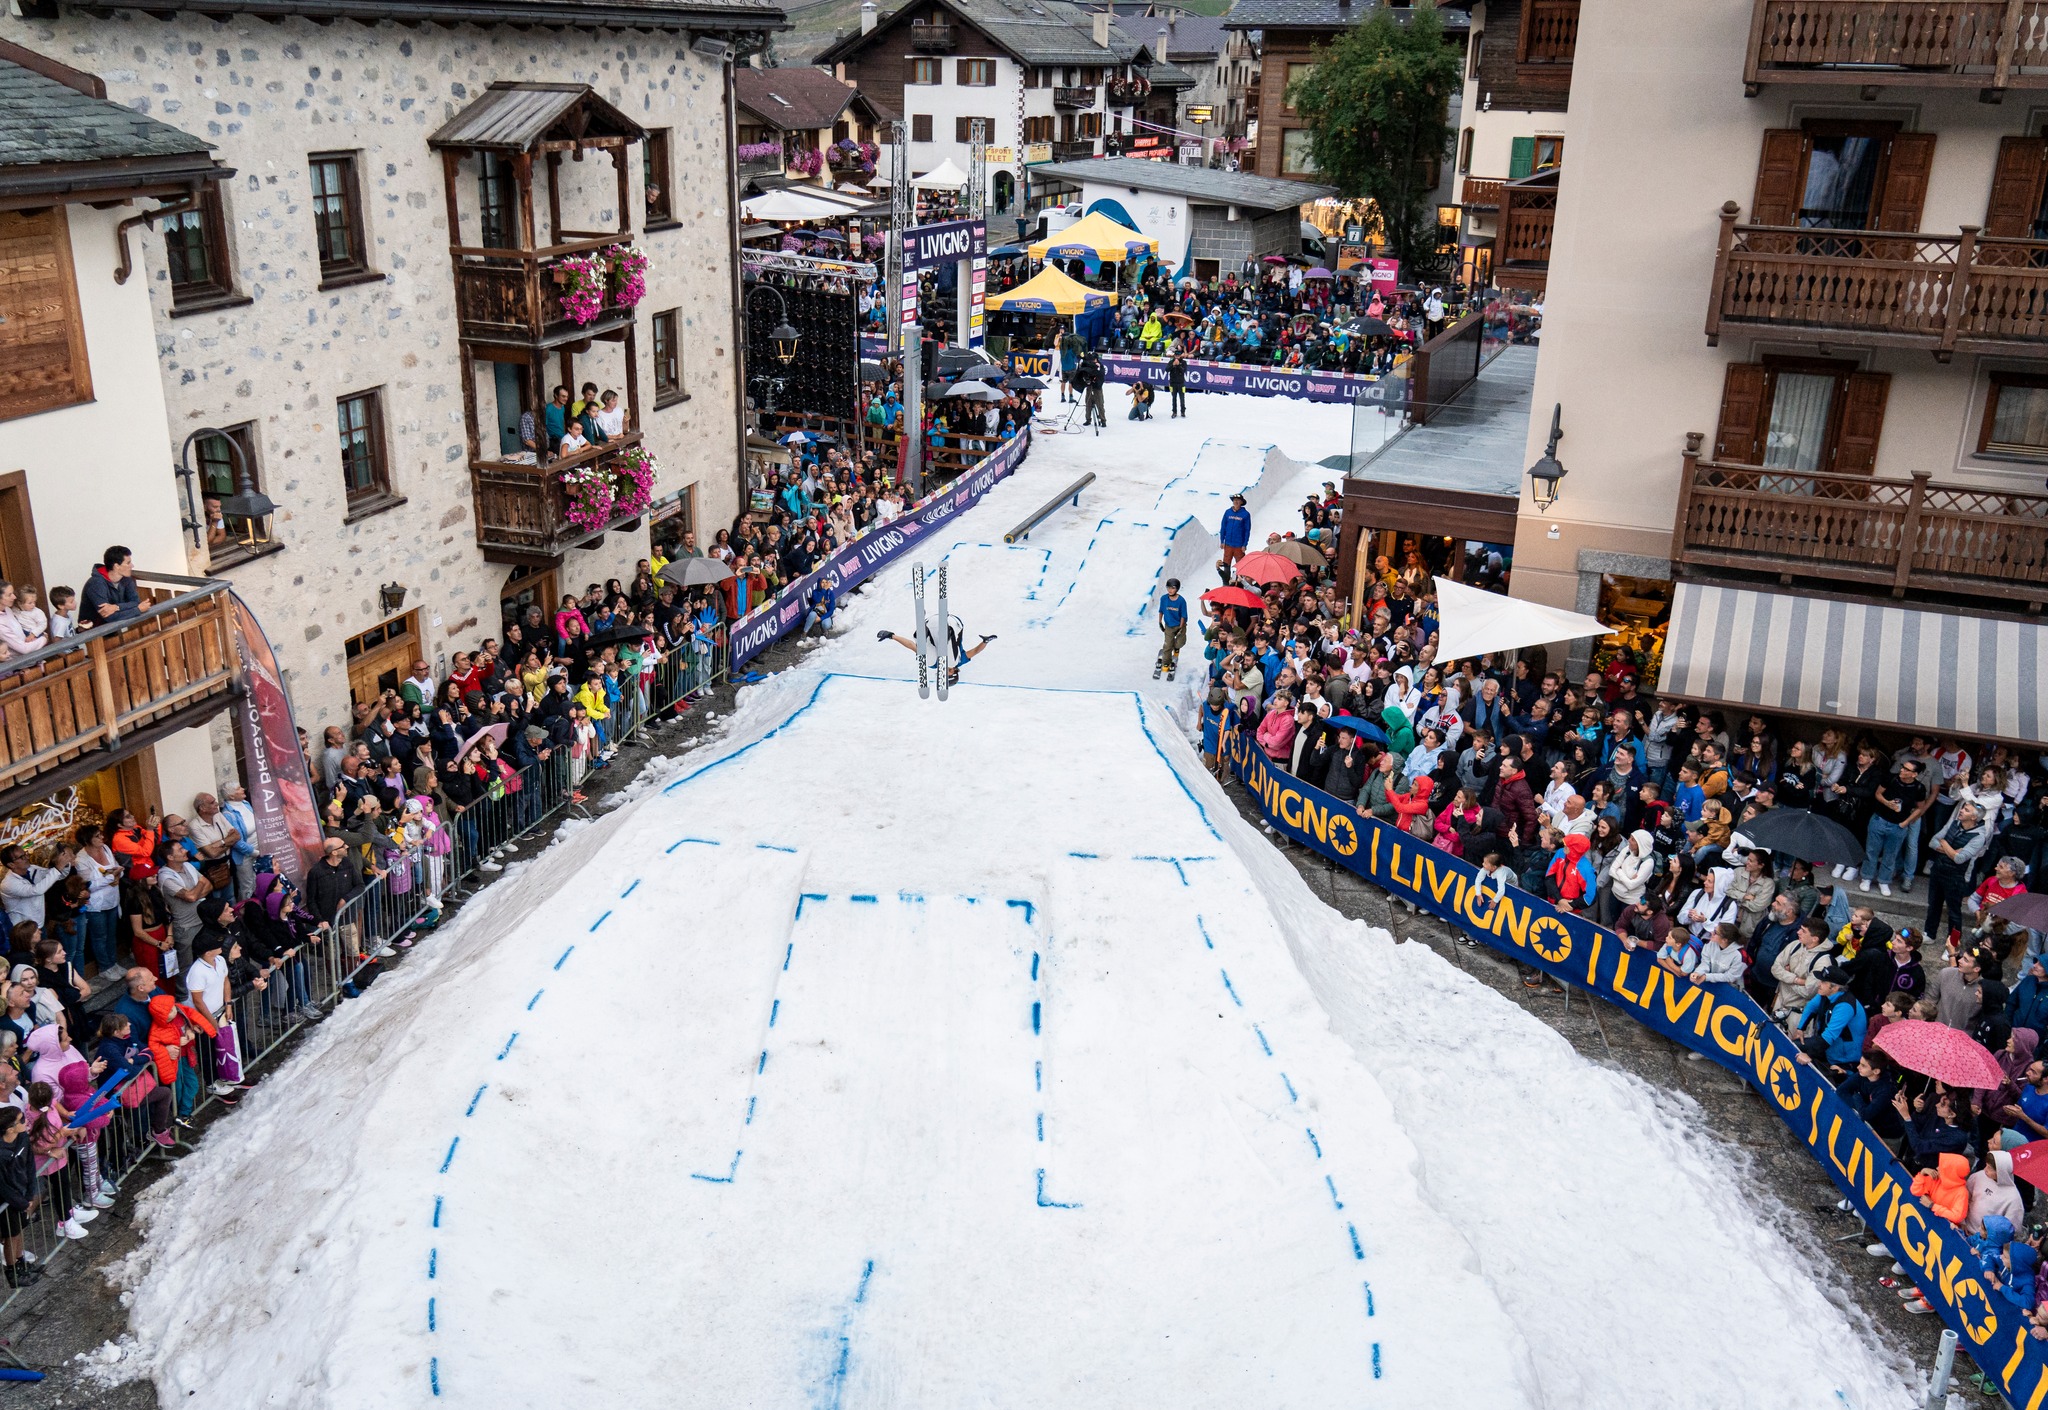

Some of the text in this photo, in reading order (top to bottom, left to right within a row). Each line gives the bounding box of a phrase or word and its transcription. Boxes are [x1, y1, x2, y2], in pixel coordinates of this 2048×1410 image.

[976, 154, 1007, 162] OTLET
[1180, 148, 1195, 156] OUT
[921, 229, 970, 260] LIVIGNO
[1059, 248, 1085, 256] LIVIGNO
[1015, 301, 1042, 309] LIVIGNO
[1148, 368, 1201, 384] LIVNO
[1245, 376, 1301, 392] LIVIGNO
[736, 615, 778, 660] LIVIGNO
[862, 530, 904, 565] LIVIGNO
[971, 468, 994, 498] LIVIGNO
[1249, 752, 1998, 1346] LIVIGNO LIVIGNO LIVIGNO LIVIGNO
